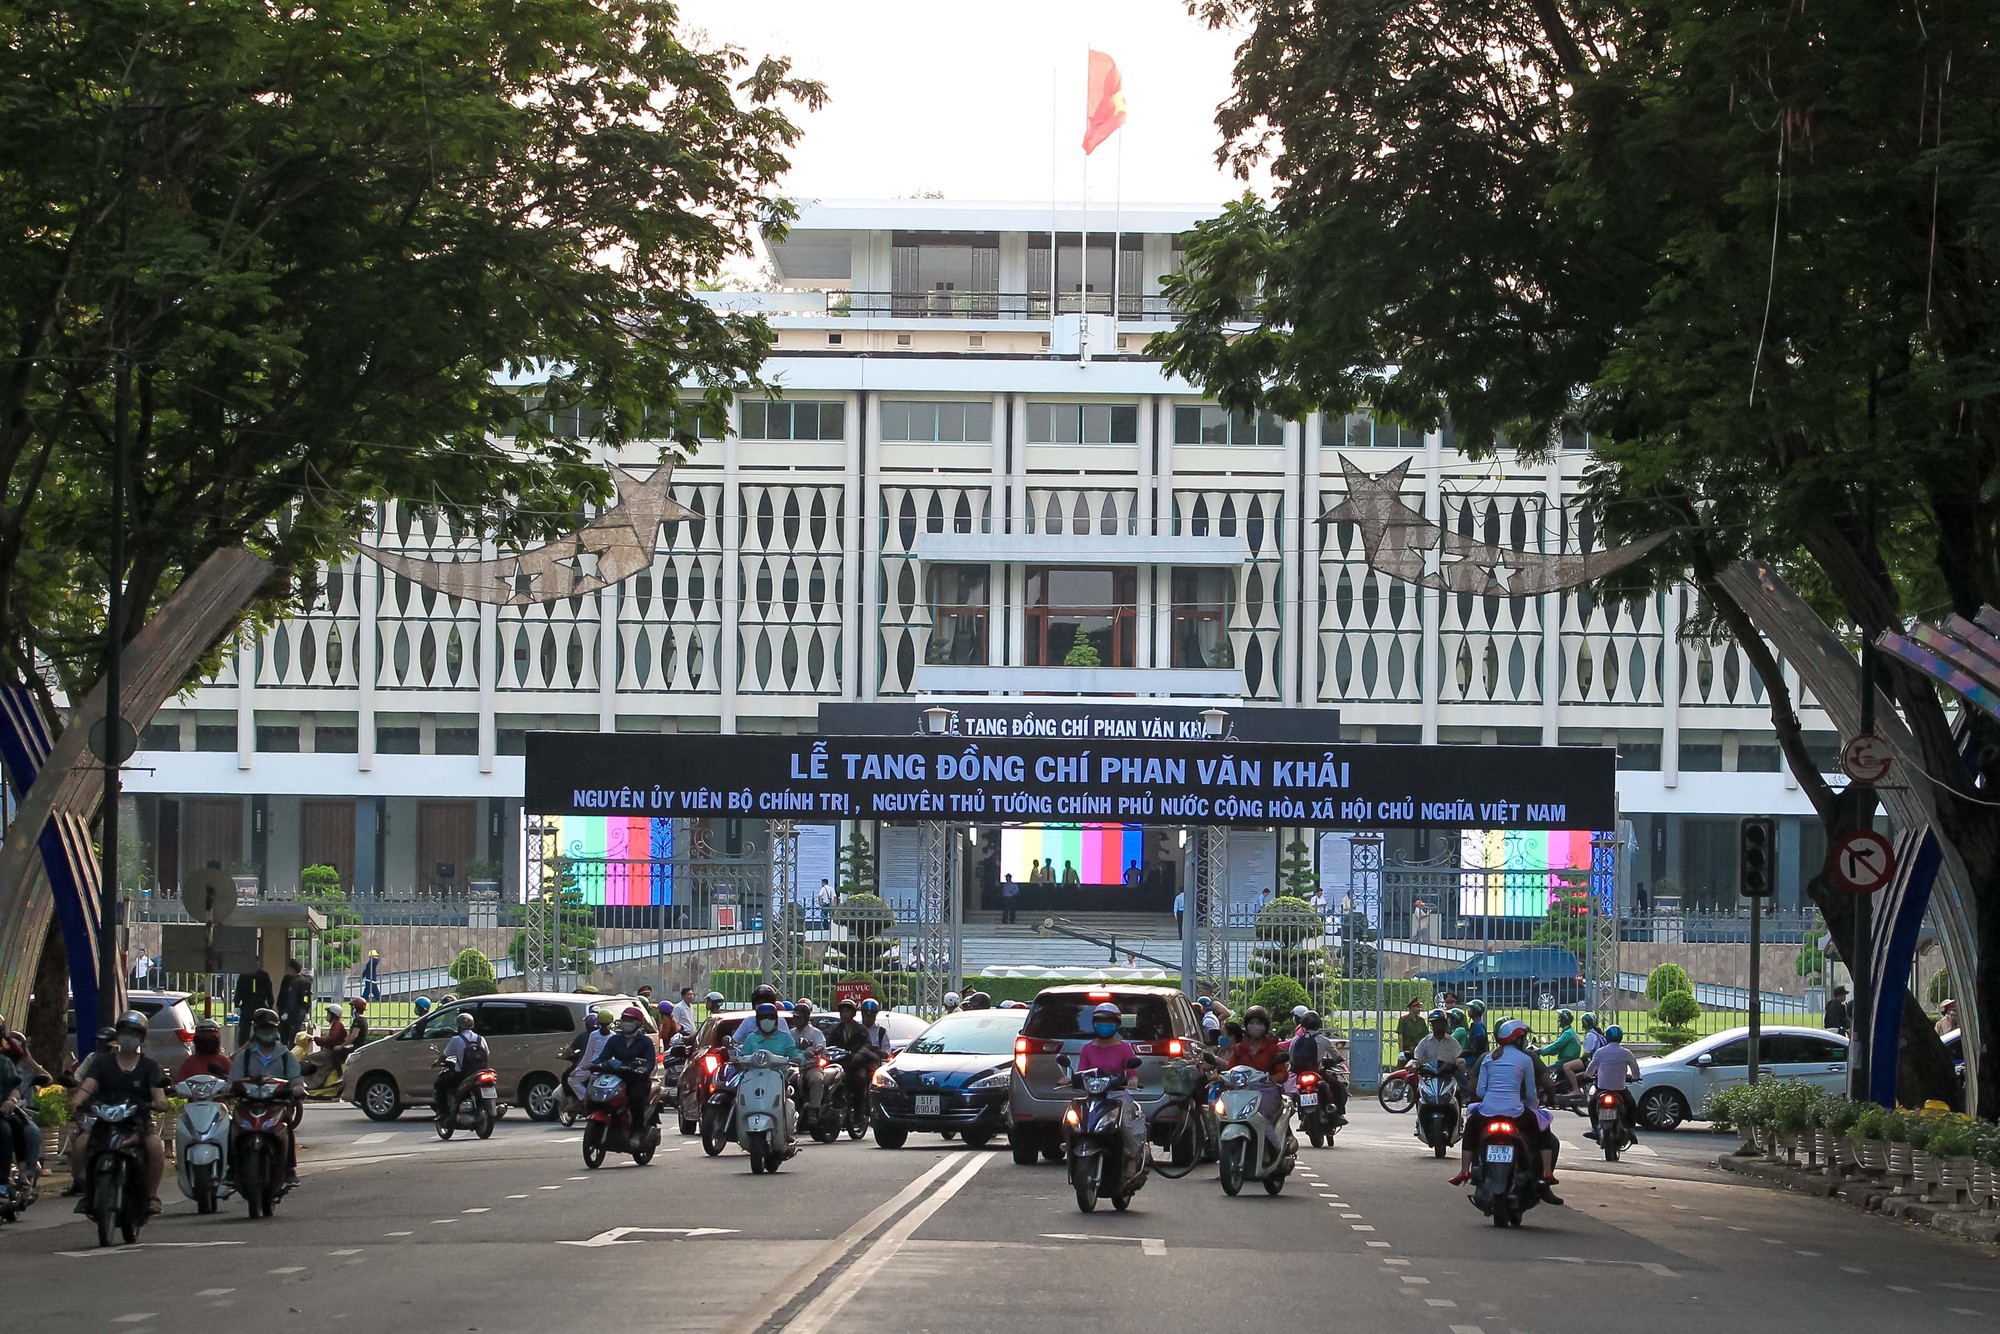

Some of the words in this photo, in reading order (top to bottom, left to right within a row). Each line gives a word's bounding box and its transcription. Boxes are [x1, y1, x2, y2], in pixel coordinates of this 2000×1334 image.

[965, 718, 1007, 736] TANG
[1012, 711, 1057, 737] ĐỒNG
[1061, 714, 1090, 737] CHÍ
[1094, 719, 1137, 738] PHAN
[1141, 716, 1174, 738] VĂN
[790, 740, 829, 780] LỄ
[841, 753, 926, 781] TANG
[936, 743, 1026, 783] ĐỒNG
[1034, 750, 1089, 784] CHÍ
[1101, 757, 1186, 785] PHAN
[1196, 754, 1261, 787] VĂN
[1272, 752, 1350, 788] KHẢI
[573, 786, 645, 810] NGUYÊN
[650, 785, 675, 810] ỦY
[680, 787, 722, 811] VIÊN
[728, 787, 753, 813] BỘ
[759, 788, 814, 811] CHÍNH
[872, 788, 944, 812] NGUYÊN
[949, 788, 985, 813] THỦ
[992, 792, 1053, 815] TƯỚNG
[1057, 792, 1112, 815] CHÍNH
[1118, 791, 1154, 816] PHỦ
[1160, 794, 1210, 817] NƯỚC
[1213, 794, 1263, 821] CỘNG
[1268, 795, 1306, 819] HÒA
[1310, 796, 1334, 820] XÃ
[1341, 797, 1372, 823] HỘI
[1377, 795, 1414, 821] CHỦ
[1420, 798, 1475, 821] NGHĨA
[1480, 799, 1521, 825] VIỆT
[1526, 804, 1567, 822] NAM
